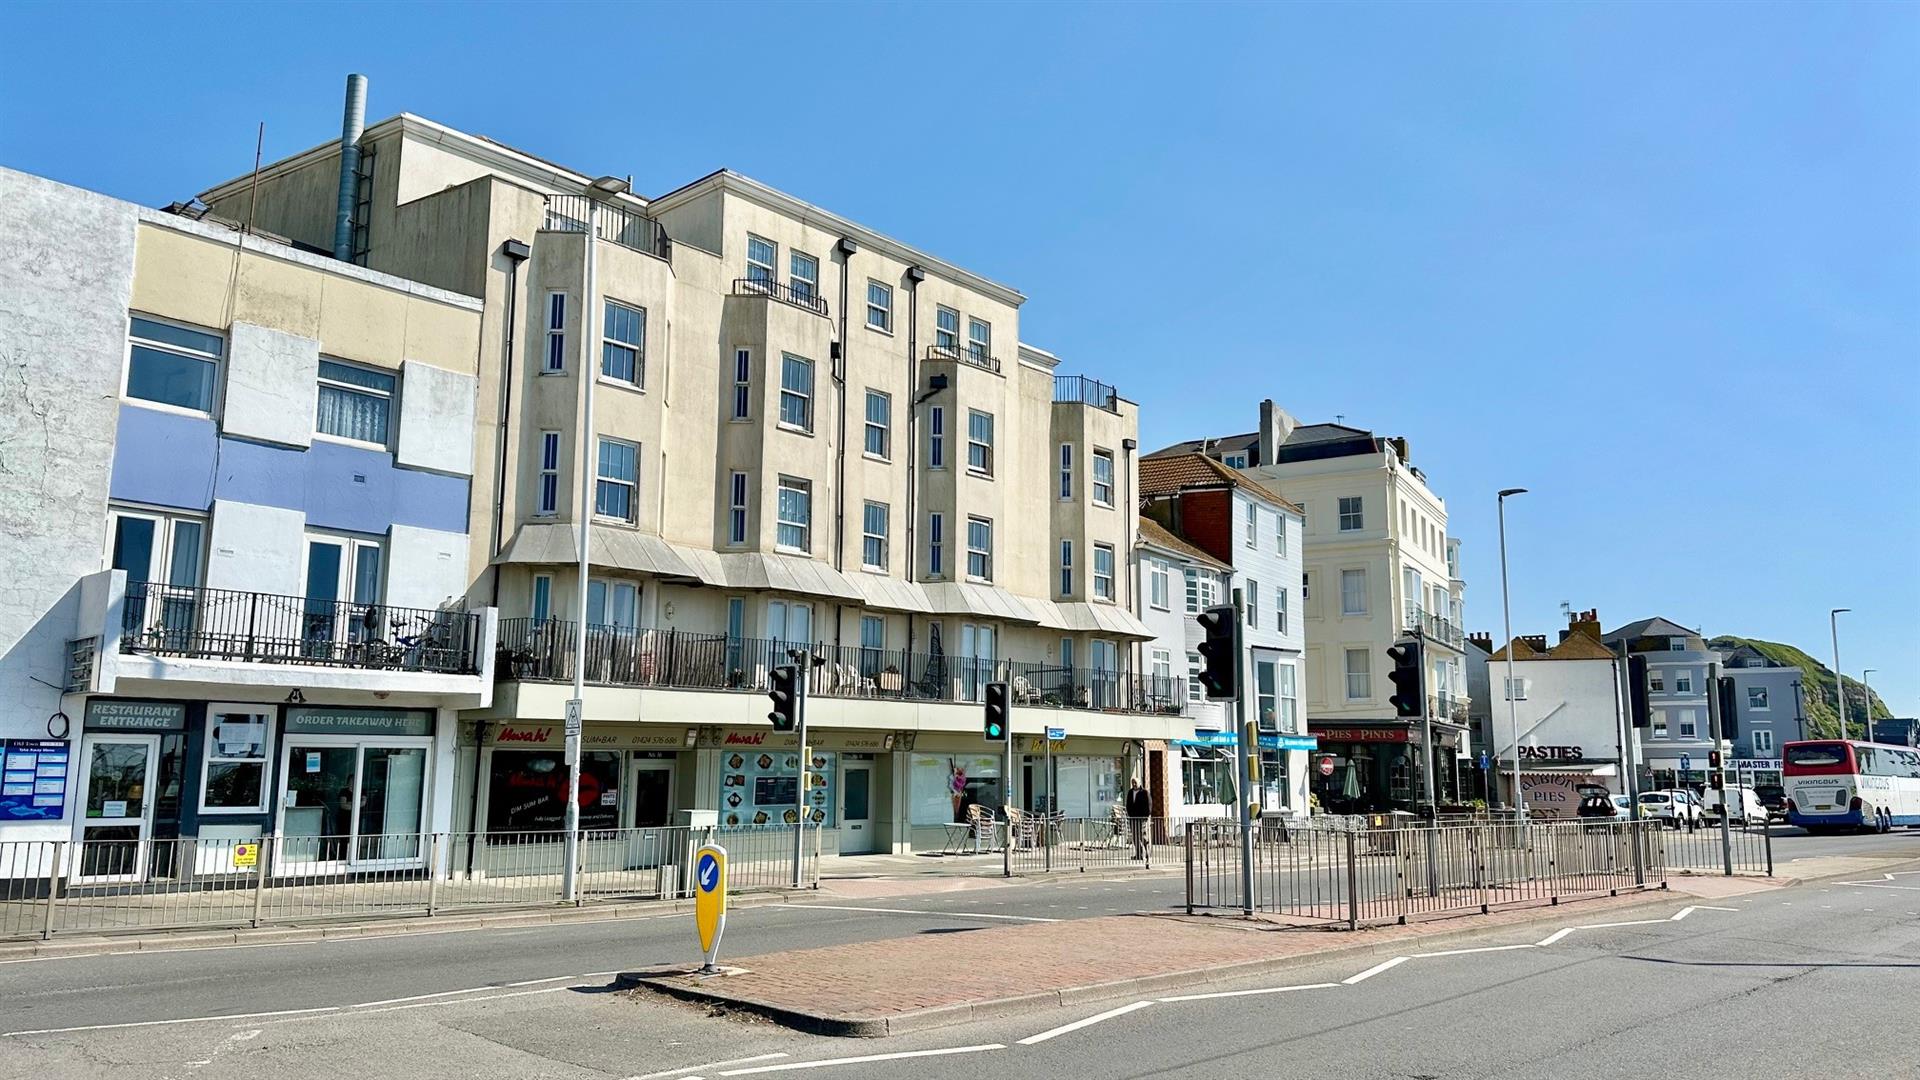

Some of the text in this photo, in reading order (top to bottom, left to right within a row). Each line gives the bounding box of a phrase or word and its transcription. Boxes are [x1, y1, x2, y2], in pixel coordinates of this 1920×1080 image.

[92, 704, 180, 717] RESTAURANT
[99, 716, 171, 727] ENTRANCE
[296, 715, 421, 728] ORDER TAKEAWAY HERE
[497, 727, 552, 743] Mwah!
[724, 732, 767, 745] Mwah!
[1327, 730, 1395, 740] PIES PINTS
[1517, 745, 1583, 760] PASTIES
[1740, 760, 1771, 769] MASTER
[1534, 791, 1566, 802] PIES
